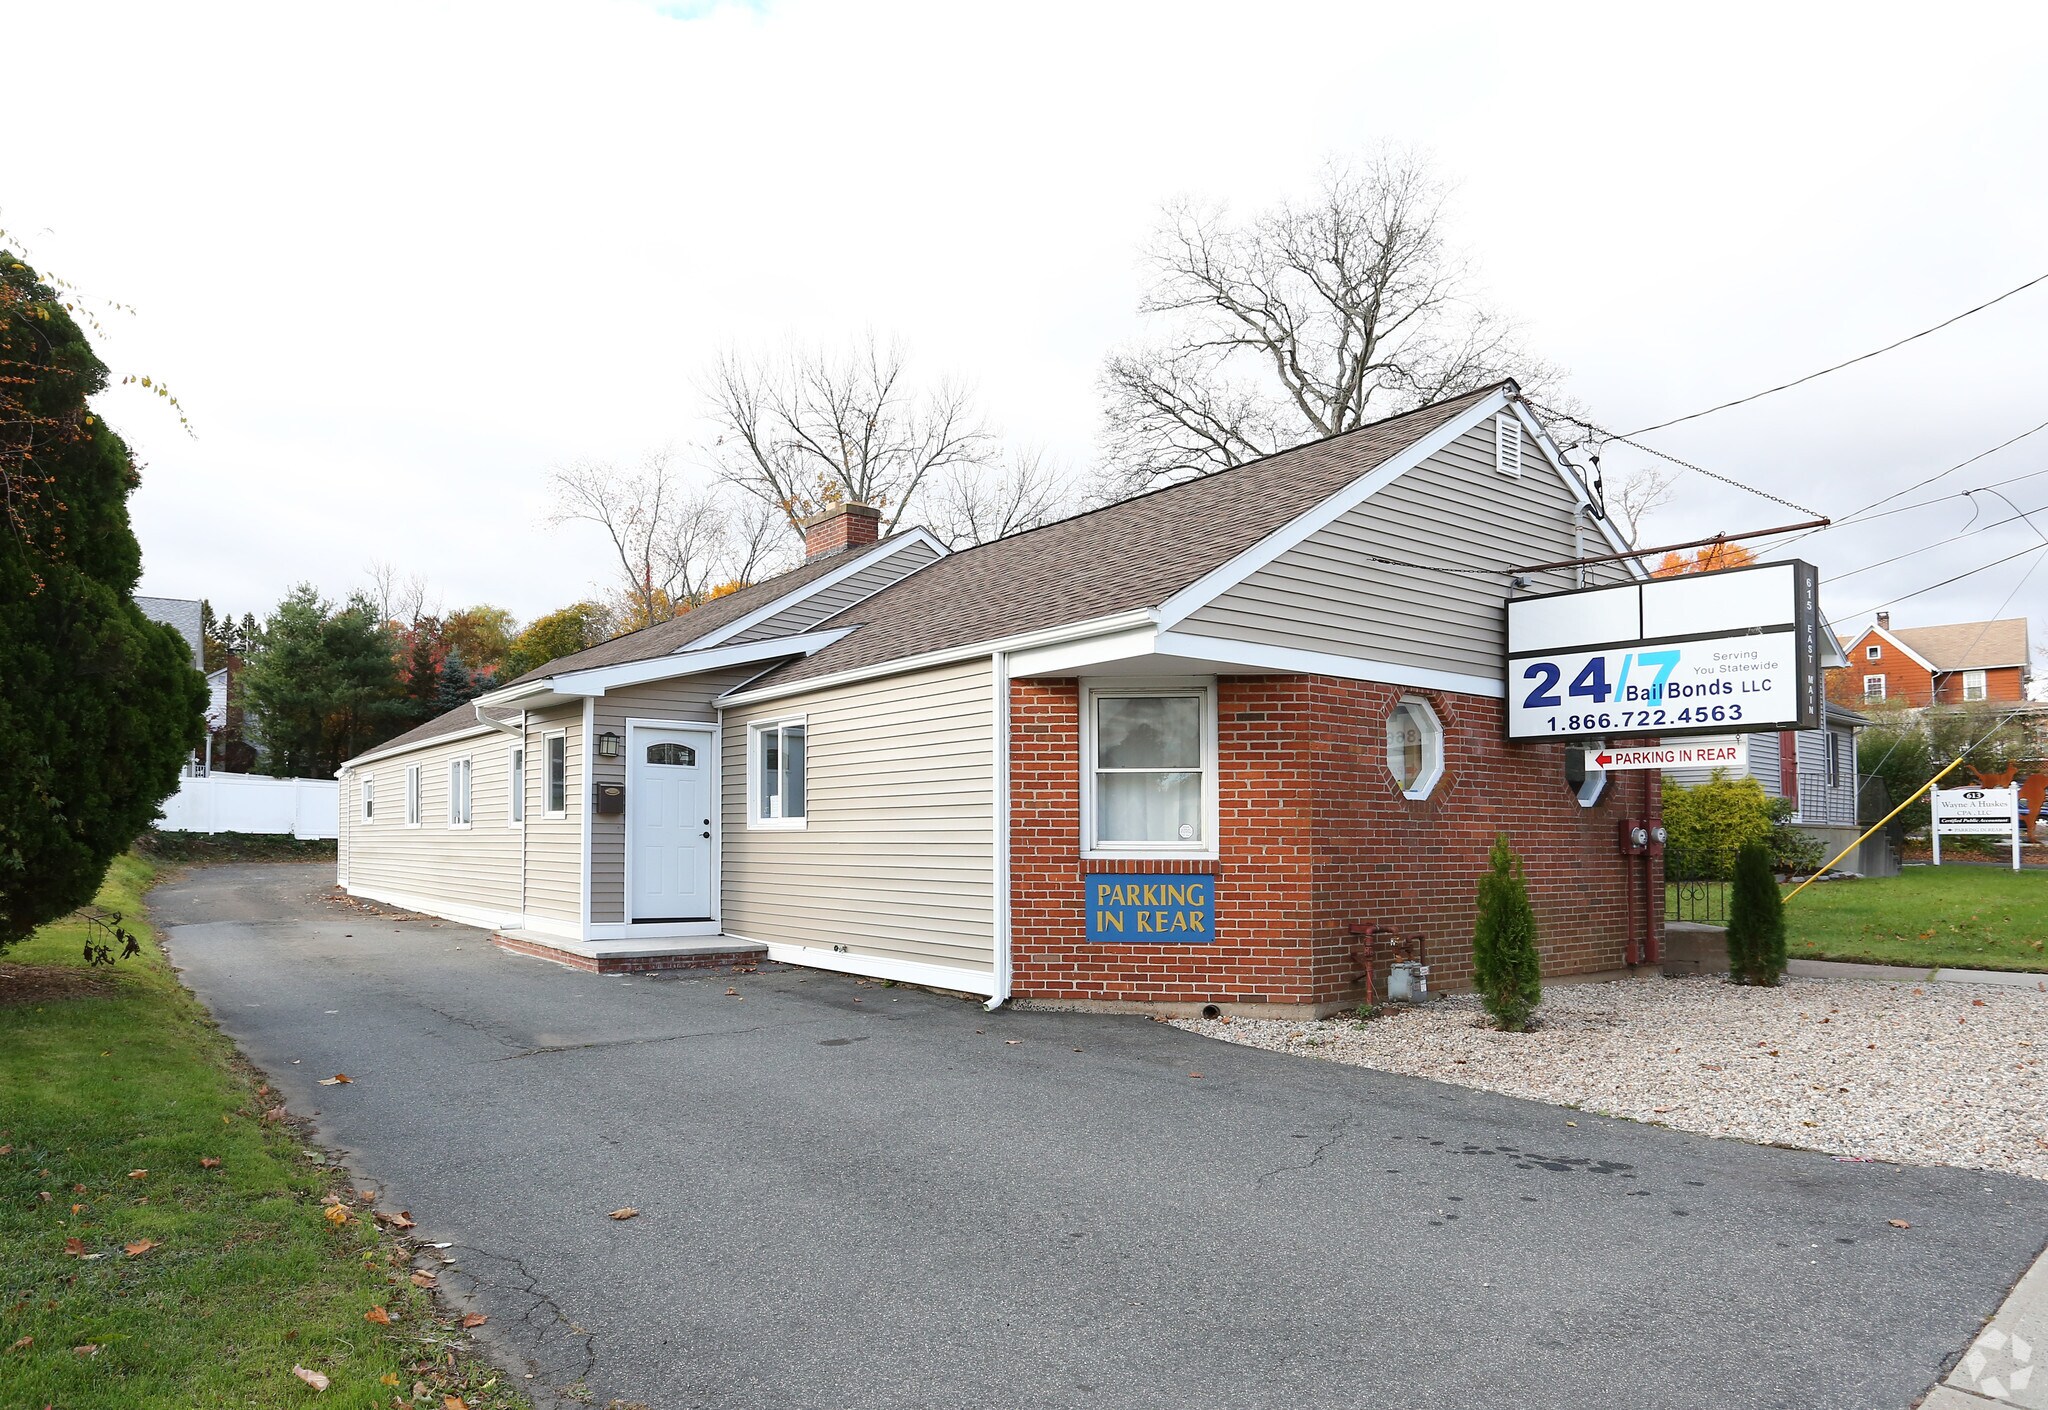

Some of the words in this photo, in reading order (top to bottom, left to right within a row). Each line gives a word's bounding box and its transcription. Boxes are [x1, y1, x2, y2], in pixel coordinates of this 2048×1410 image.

[1805, 577, 1813, 611] 615
[1713, 650, 1758, 661] Serving
[1806, 624, 1814, 664] EAST
[1523, 650, 1681, 709] 24/7
[1693, 666, 1715, 675] You
[1719, 661, 1779, 673] Statewide
[1626, 683, 1663, 701] Bail
[1668, 678, 1733, 699] Bonds
[1742, 679, 1772, 693] LLC
[1807, 674, 1815, 716] MAIN
[1547, 704, 1743, 731] 1.866.722.4563
[1615, 750, 1675, 765] PARKING
[1679, 749, 1692, 762] IN
[1697, 747, 1737, 761] REAR
[1941, 801, 1968, 809] Wayne
[1097, 883, 1205, 906] PARKING
[1096, 911, 1124, 933] IN
[1136, 910, 1206, 933] REAR
